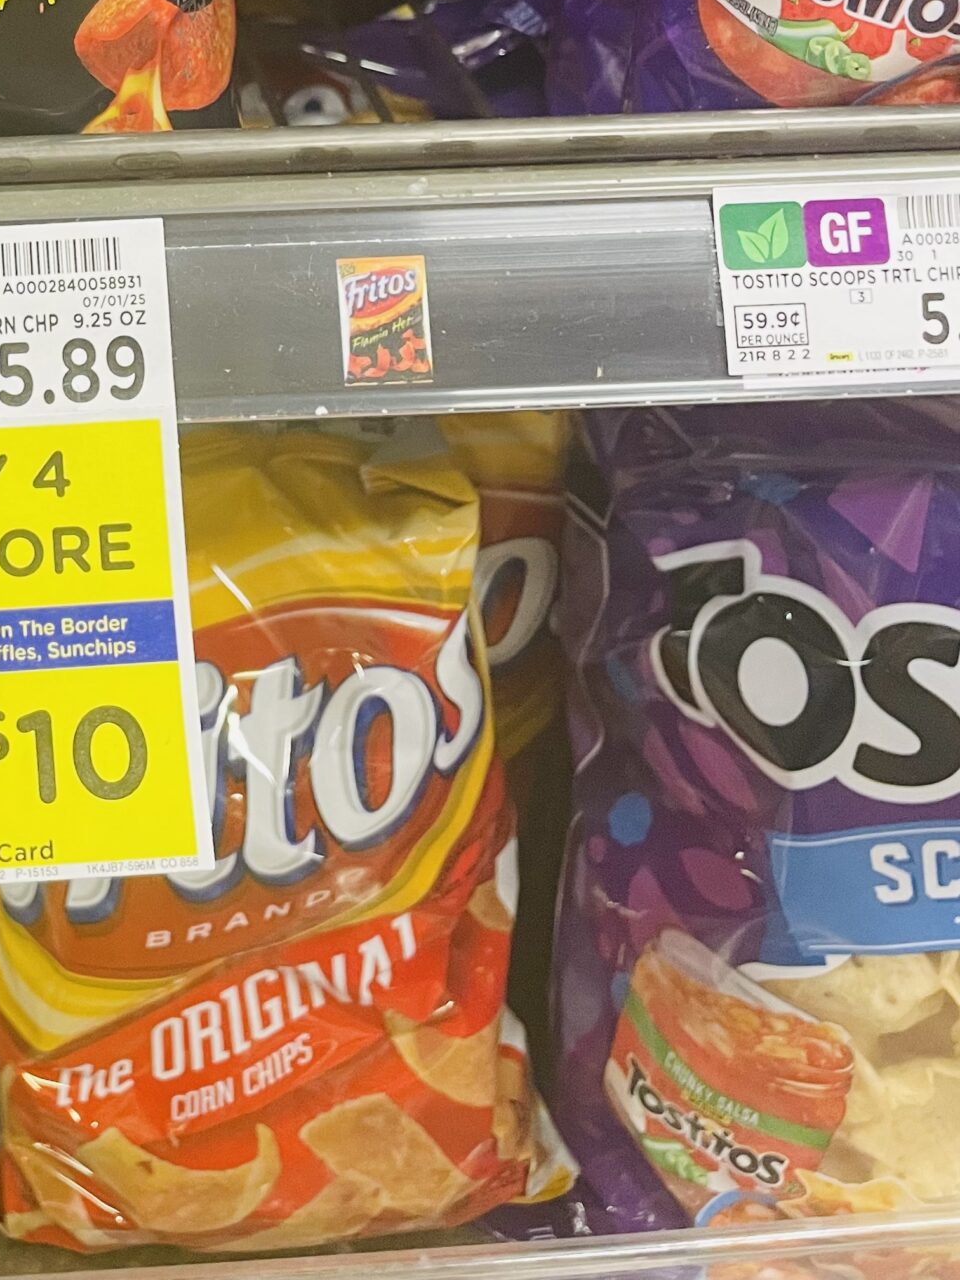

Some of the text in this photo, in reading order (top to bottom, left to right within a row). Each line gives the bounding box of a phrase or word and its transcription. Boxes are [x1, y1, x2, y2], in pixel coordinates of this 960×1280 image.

[819, 210, 873, 255] GF
[897, 249, 914, 262] 30
[2, 275, 143, 295] A0002840058931
[731, 272, 804, 291] TOSTITO
[809, 269, 877, 288] SCOOPS
[882, 267, 923, 284] TRTL
[82, 293, 147, 309] 07/01/25
[343, 269, 417, 319] Fritos
[23, 313, 60, 334] CHP
[73, 311, 113, 330] 9.25
[119, 310, 147, 326] OZ
[742, 310, 801, 330] 59.9¢
[740, 332, 807, 346] PER OUNCE
[738, 350, 767, 363] 21R
[772, 349, 782, 361] 8
[787, 349, 797, 361] 2
[802, 349, 812, 361] 2
[31, 450, 71, 498] 4
[18, 619, 56, 638] The
[61, 615, 129, 636] Border
[47, 638, 137, 662] Sunchips
[144, 888, 335, 950] BRAND
[170, 1032, 315, 1123] CORN CHIPS
